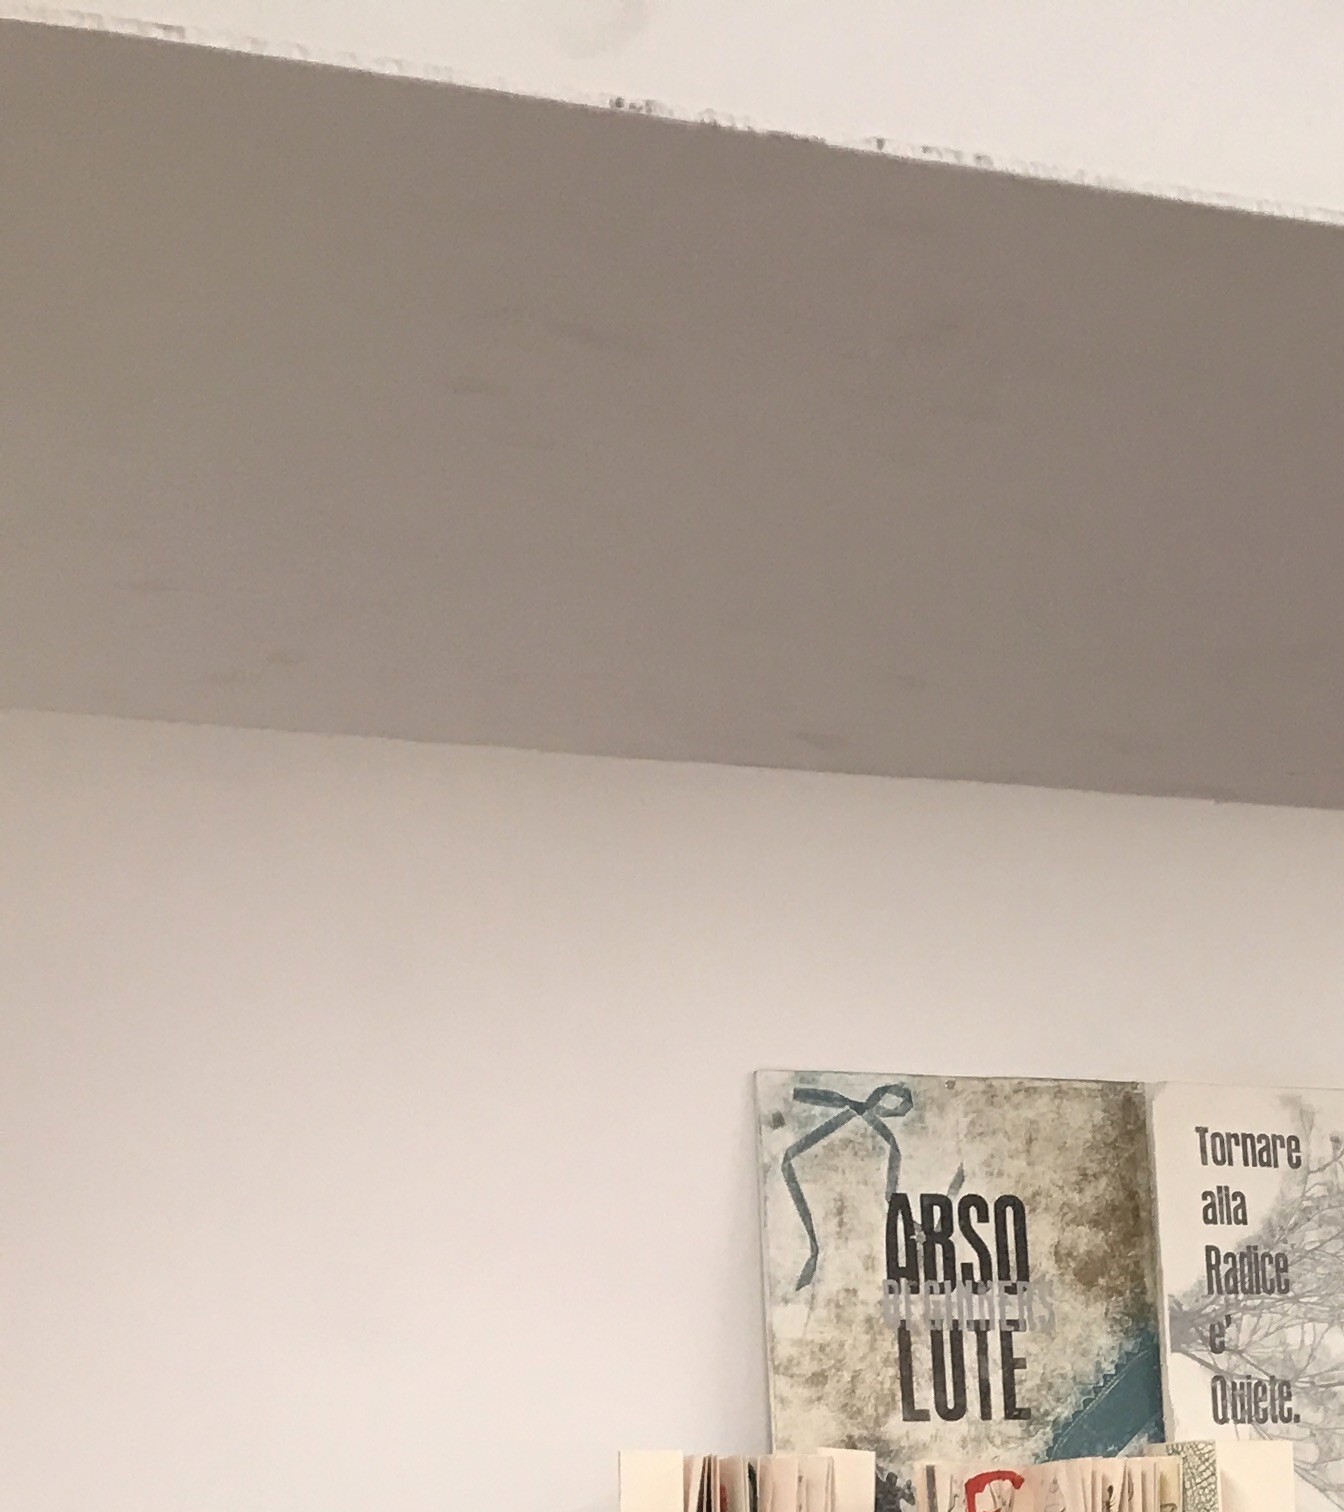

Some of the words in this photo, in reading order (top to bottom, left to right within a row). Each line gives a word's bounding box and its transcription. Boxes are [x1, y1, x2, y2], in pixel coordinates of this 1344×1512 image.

[1195, 1126, 1302, 1169] Tornare
[1201, 1186, 1248, 1226] alla
[886, 1193, 1030, 1294] ABSO
[1205, 1245, 1291, 1296] Radice
[898, 1318, 1033, 1421] LUTE
[1211, 1375, 1301, 1426] Quiete.
